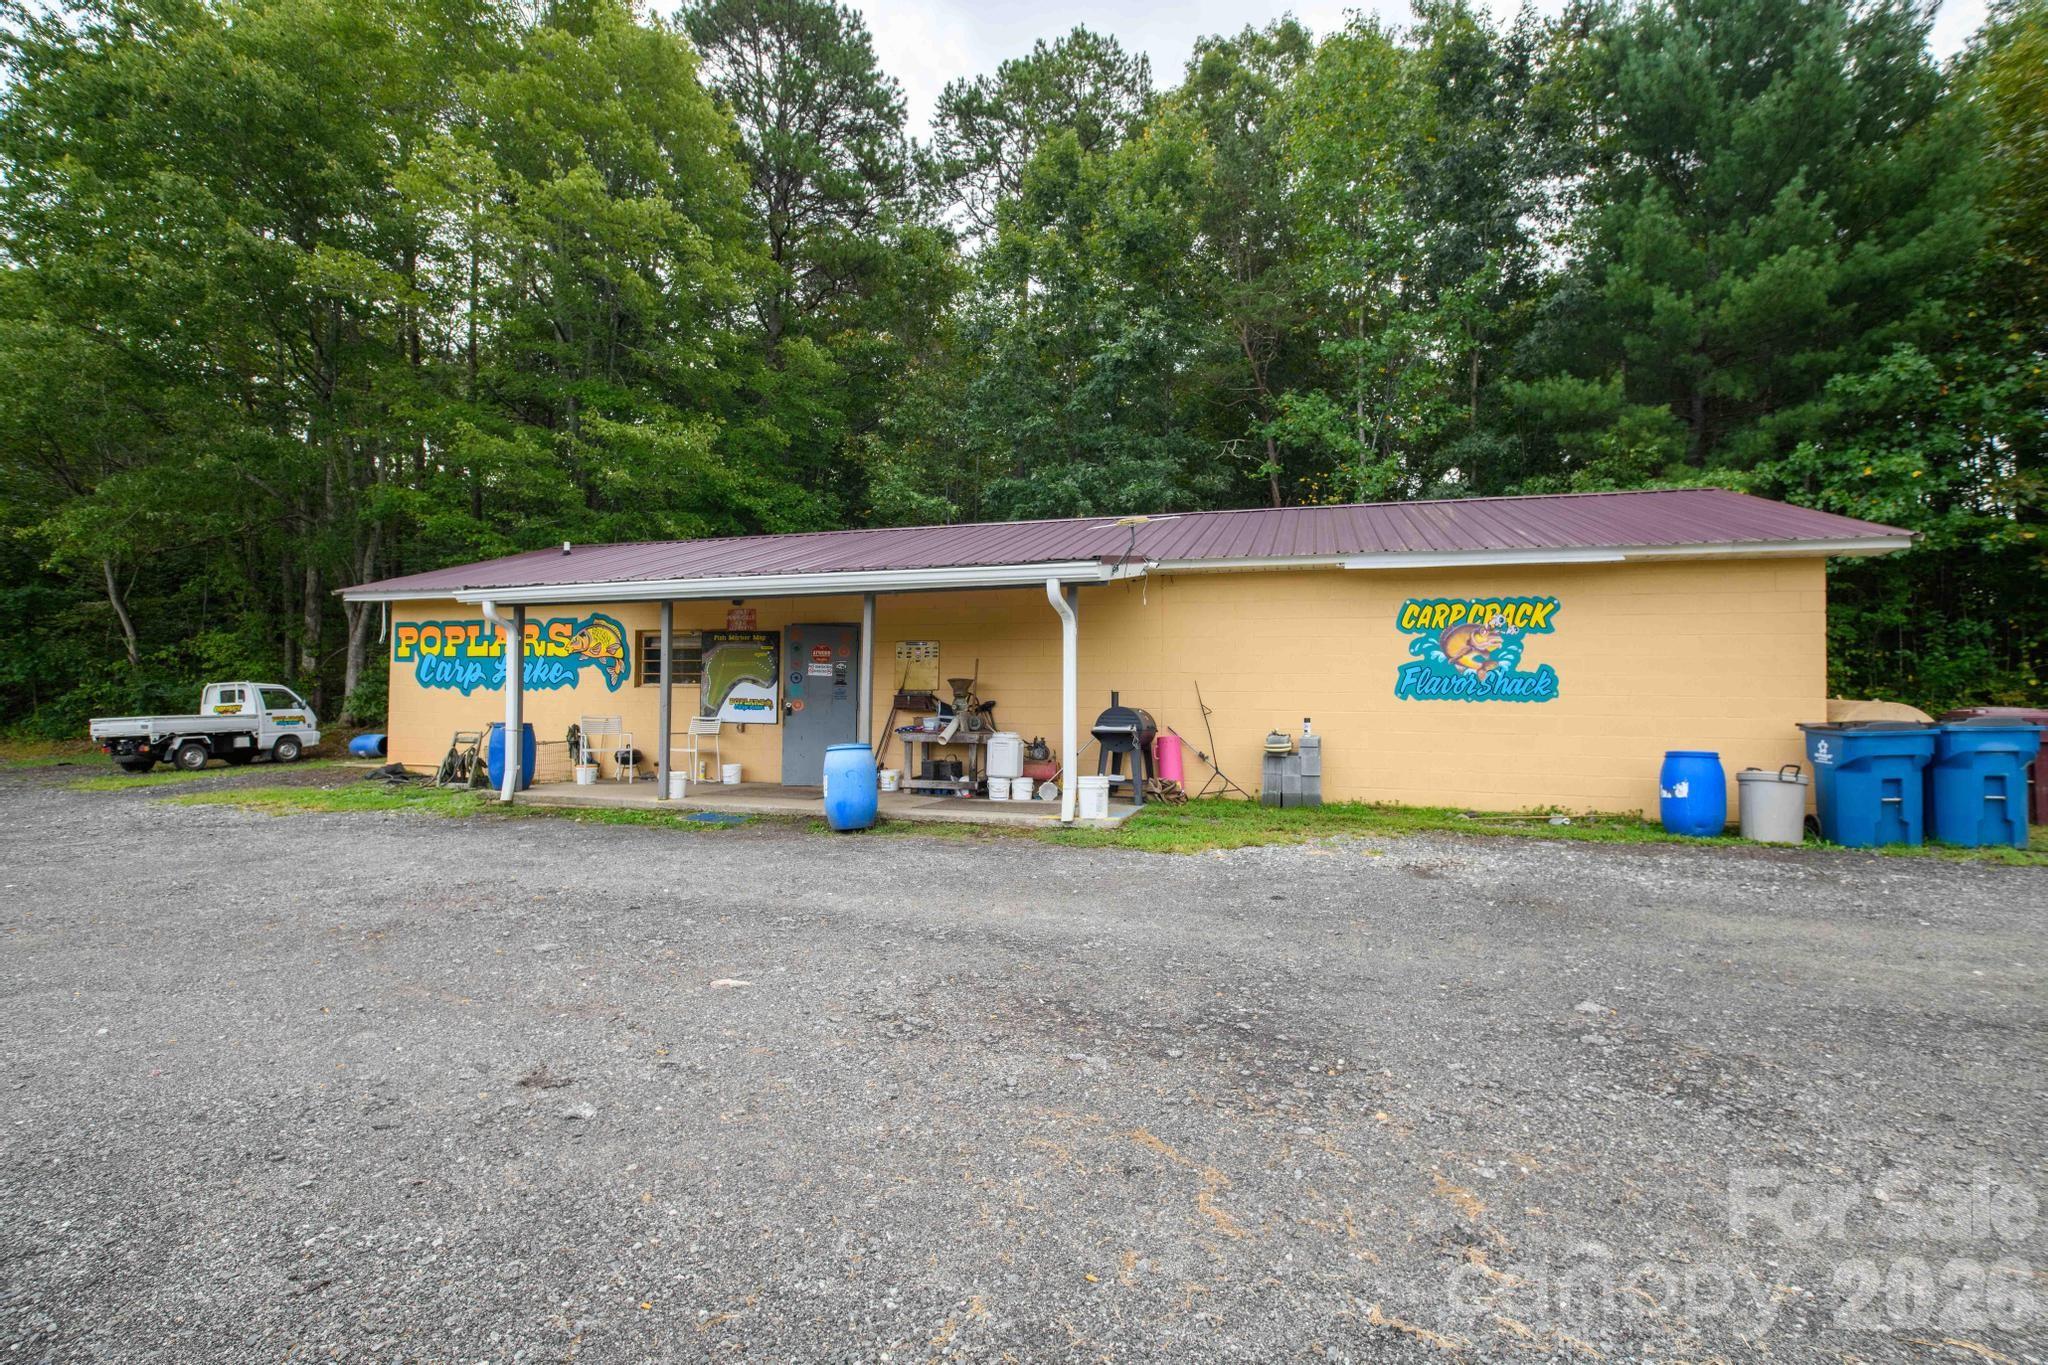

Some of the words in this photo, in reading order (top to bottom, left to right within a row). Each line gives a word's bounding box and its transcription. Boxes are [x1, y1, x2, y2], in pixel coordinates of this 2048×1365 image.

[1401, 603, 1466, 629] CARP
[1467, 601, 1555, 629] CRACK
[397, 622, 572, 657] POPLARS
[419, 653, 487, 689] Carp
[1400, 666, 1478, 695] Flavor
[1476, 669, 1552, 696] Shack
